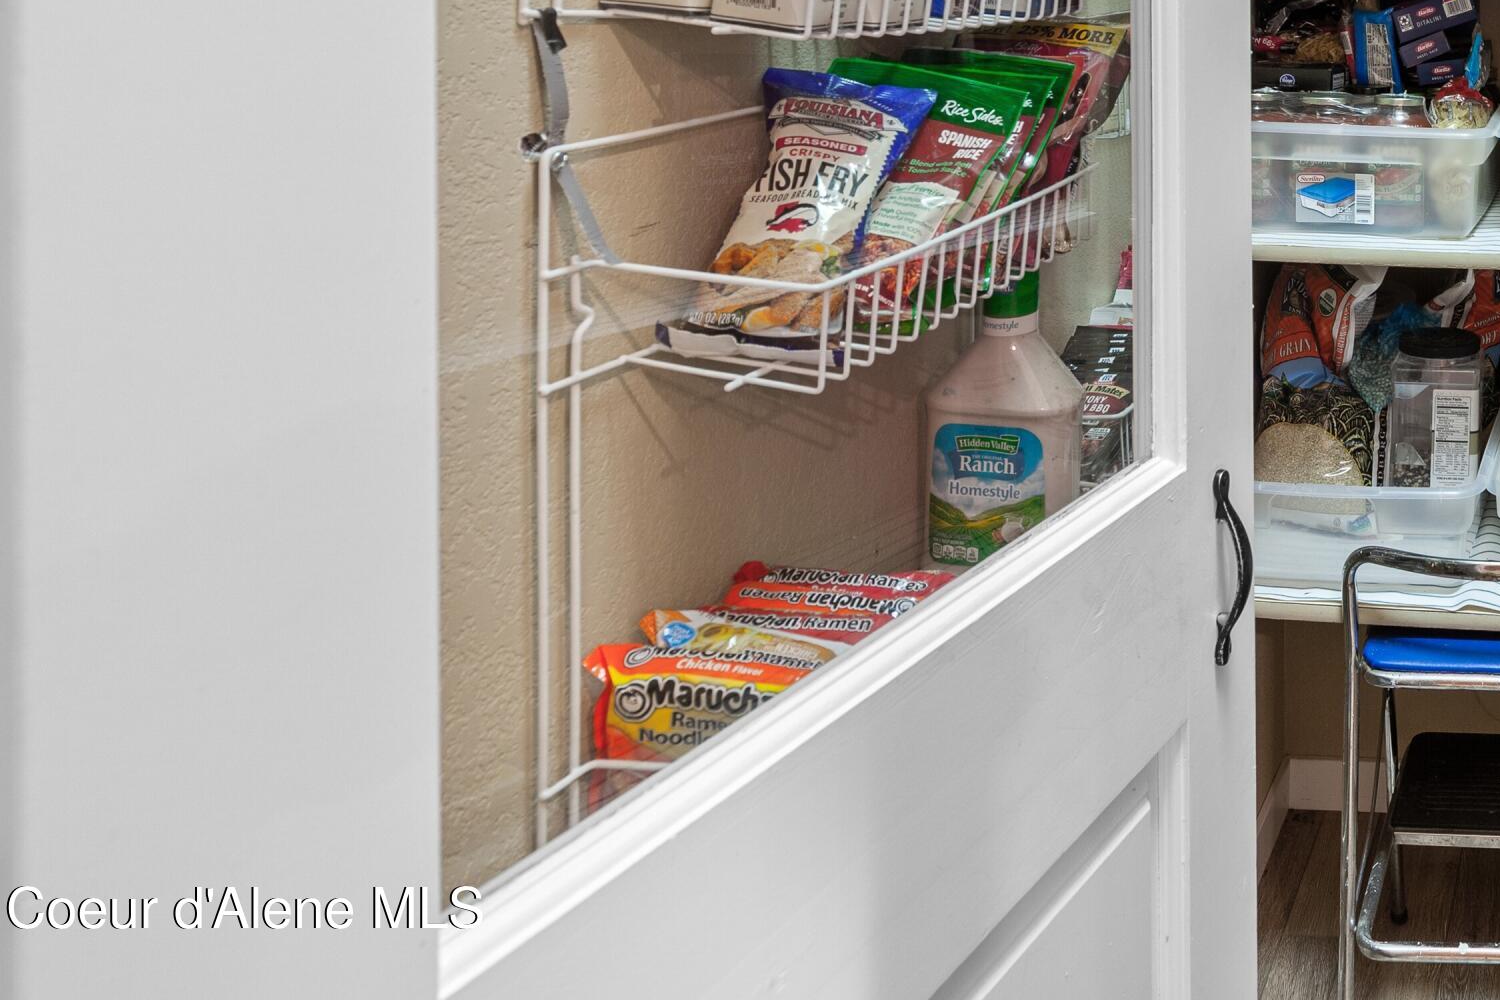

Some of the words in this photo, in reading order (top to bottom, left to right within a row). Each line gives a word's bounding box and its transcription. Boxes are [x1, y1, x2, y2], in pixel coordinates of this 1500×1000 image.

[1416, 14, 1443, 28] DITALINI
[1058, 27, 1116, 46] MORE
[784, 96, 884, 131] LOUISIANA
[941, 99, 970, 118] Rice
[964, 106, 1004, 128] Sides
[783, 136, 858, 153] SEASONED
[937, 129, 993, 149] SPANISH
[788, 147, 841, 163] CRISPY
[951, 148, 982, 161] RICE
[754, 158, 813, 194] FISH
[812, 160, 869, 198] FRY
[748, 191, 790, 205] SEAFOOD
[840, 197, 859, 211] MIX
[1279, 338, 1311, 358] GRAIN
[1084, 395, 1108, 405] OKY
[1088, 404, 1111, 414] BBQ
[959, 439, 991, 449] Hidden
[990, 440, 1017, 453] Valley
[959, 454, 1016, 476] Ranch
[949, 480, 1021, 501] Homestyle
[777, 567, 861, 586] Maruchan
[739, 587, 802, 605] Ramen
[802, 615, 872, 632] Ramen
[675, 658, 731, 674] Chicken
[731, 664, 765, 677] Flavor
[645, 674, 776, 717] Maruch
